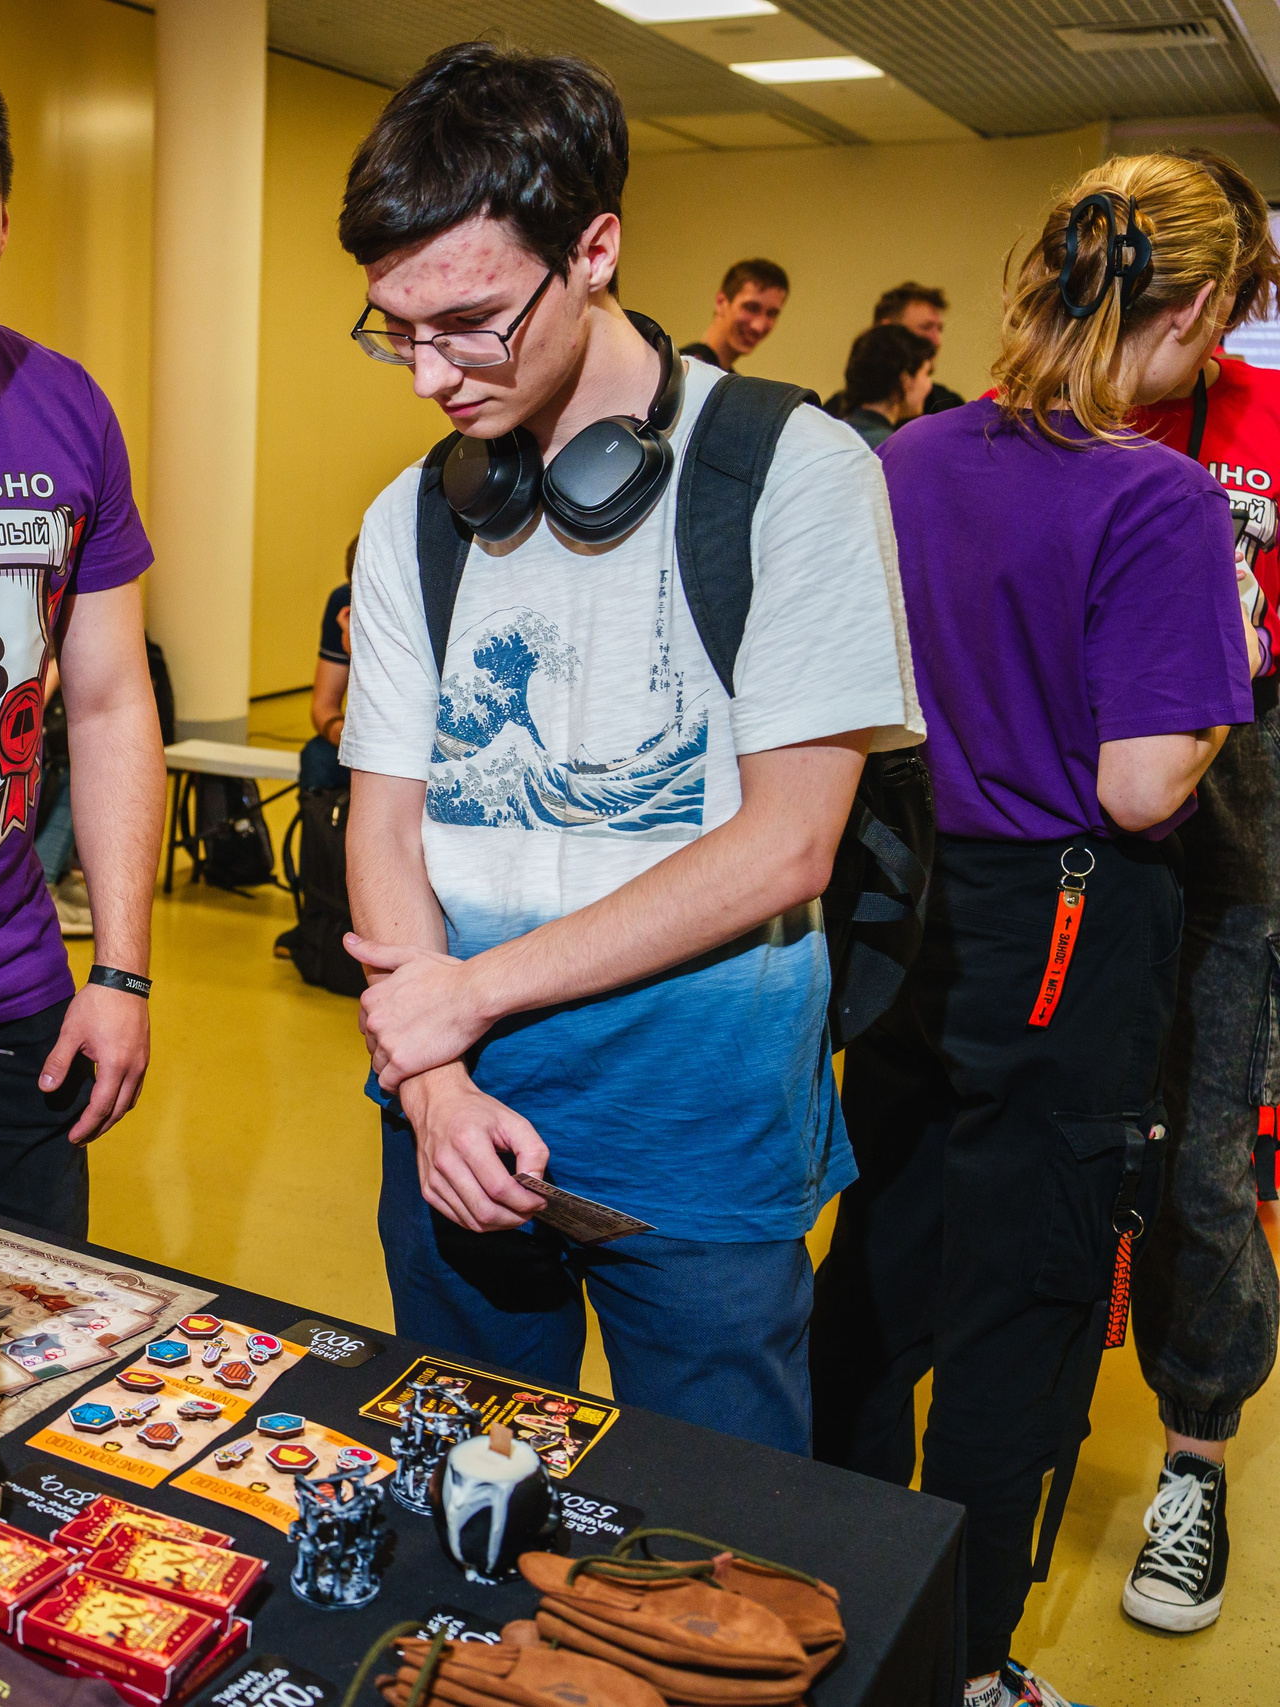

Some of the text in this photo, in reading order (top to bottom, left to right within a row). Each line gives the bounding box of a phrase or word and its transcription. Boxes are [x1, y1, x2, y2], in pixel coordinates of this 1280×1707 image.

[1054, 932, 1071, 965] ЗАНОС
[1044, 977, 1060, 1005] МЕТР
[46, 1435, 155, 1477] LIVING ROOM STUDIO
[191, 1476, 232, 1495] STUDIO
[231, 1491, 265, 1507] ROOM
